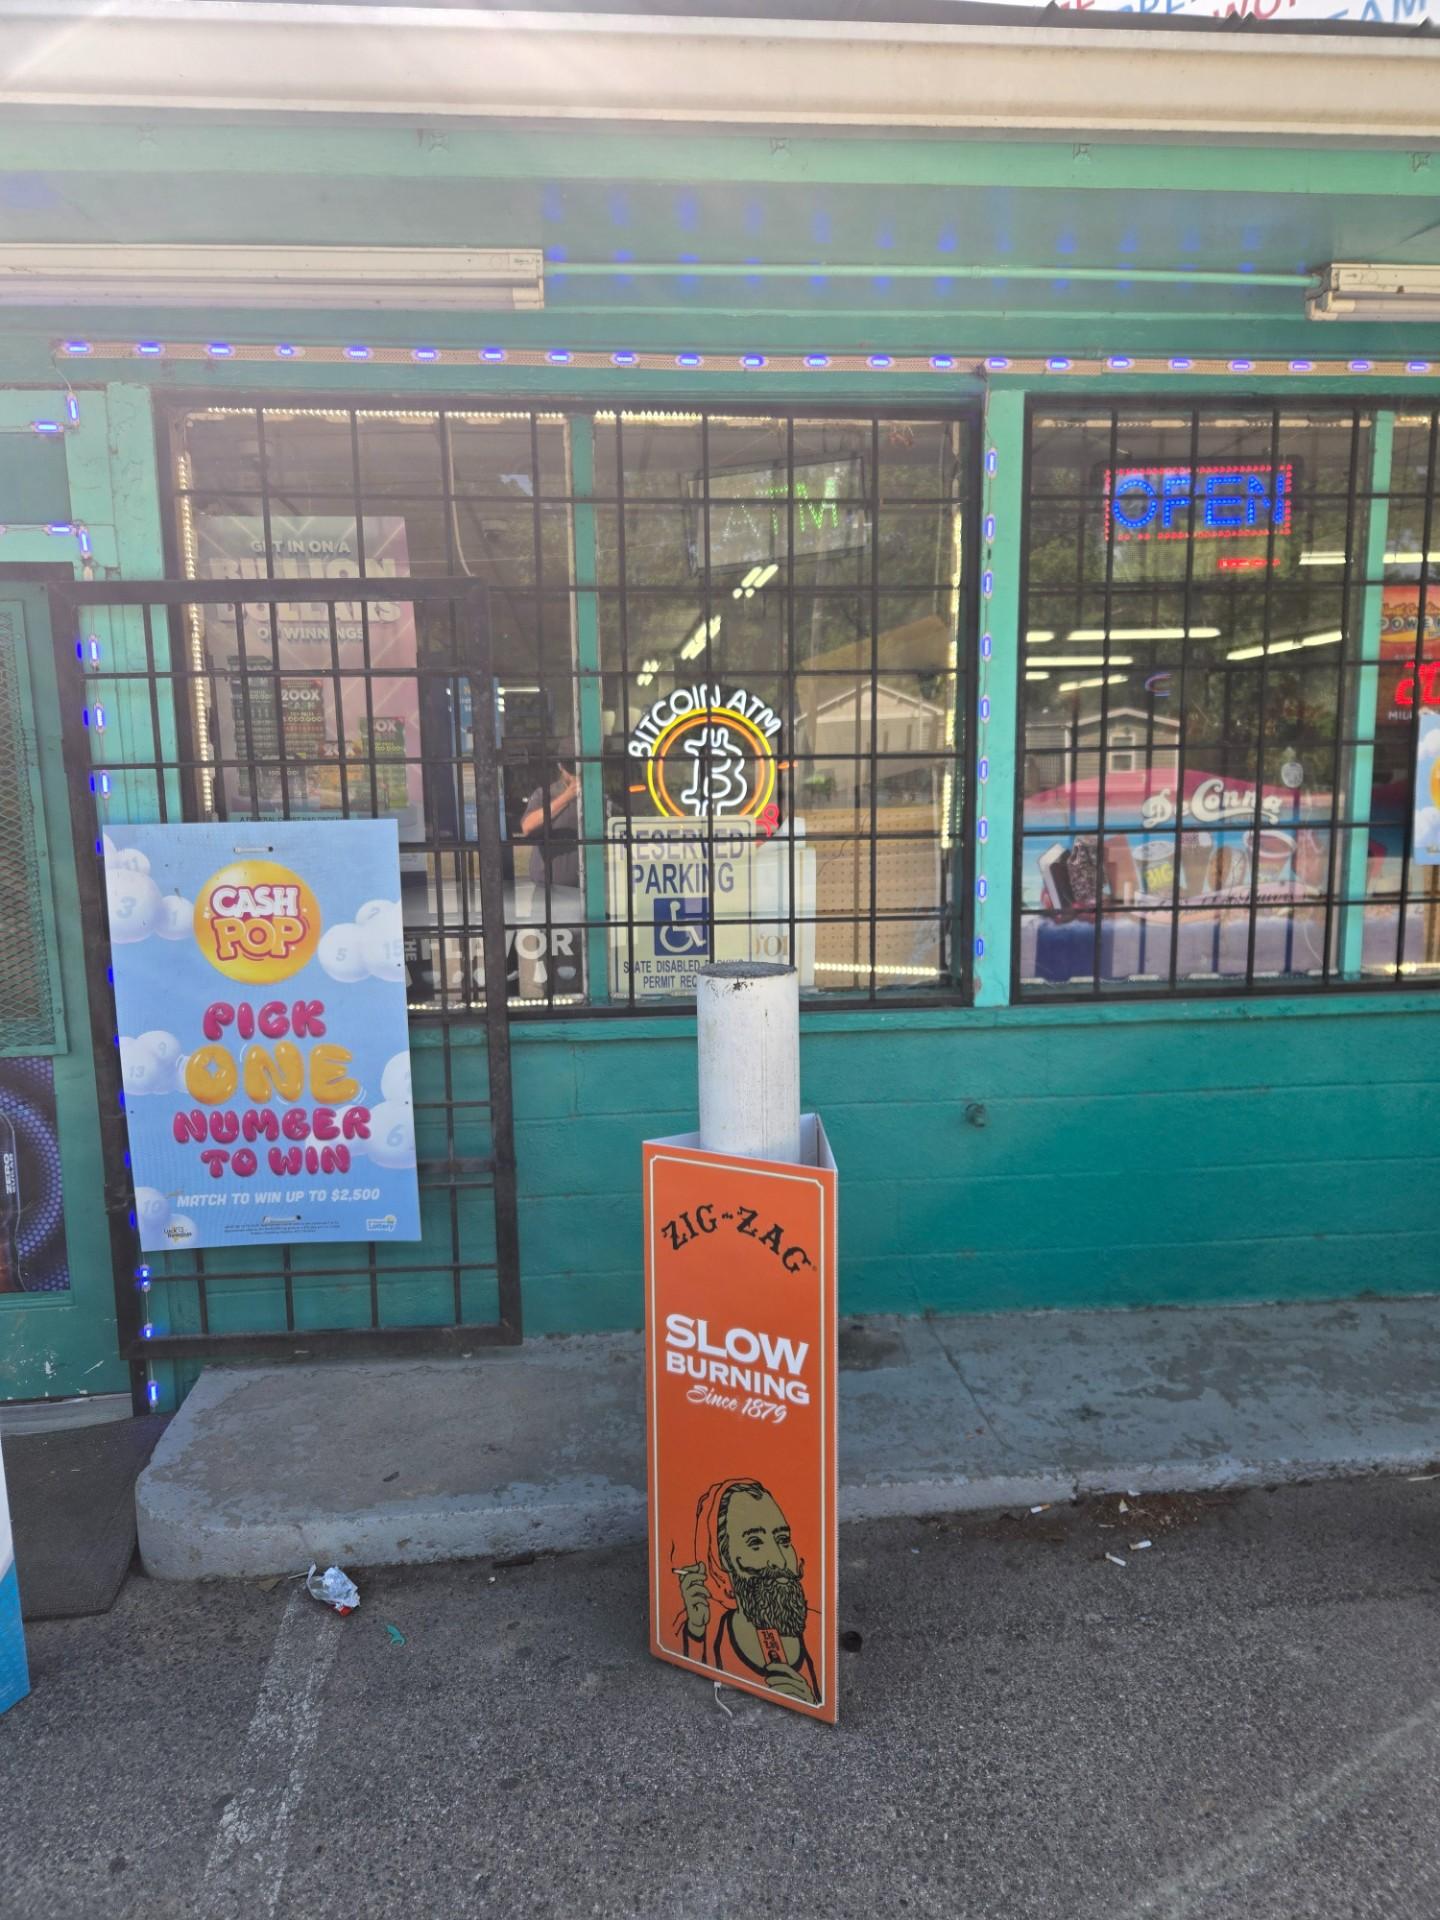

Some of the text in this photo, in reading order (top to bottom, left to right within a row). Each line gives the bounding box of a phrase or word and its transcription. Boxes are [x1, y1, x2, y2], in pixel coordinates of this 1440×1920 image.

[722, 480, 840, 542] ATM
[1112, 474, 1286, 528] OPEN
[250, 540, 351, 554] GT IN ON A
[283, 626, 364, 641] WINNNGS
[281, 688, 321, 701] 200X
[628, 684, 782, 758] BITCOIN ATM
[631, 862, 735, 894] PARKING
[116, 896, 137, 918] 3
[211, 885, 301, 918] CASH
[211, 916, 306, 961] POP
[336, 947, 348, 962] 5
[623, 960, 652, 974] SATE
[656, 958, 701, 973] DISABLED
[643, 975, 676, 988] PERMIT
[203, 999, 327, 1041] PICK
[184, 1041, 361, 1105] ONE
[172, 1106, 372, 1145] NUMBER
[387, 1125, 405, 1147] 6
[3, 1153, 13, 1195] ZERO
[200, 1144, 351, 1179] TO WIN
[176, 1193, 227, 1208] MATCH
[231, 1192, 250, 1205] TO
[254, 1191, 282, 1204] WIN
[285, 1190, 305, 1203] UP
[309, 1190, 329, 1202] TO
[660, 1203, 813, 1275] ZIG-ZAG
[665, 1313, 809, 1376] SLOW
[666, 1350, 811, 1406] BURNING
[686, 1384, 788, 1425] Since 1879
